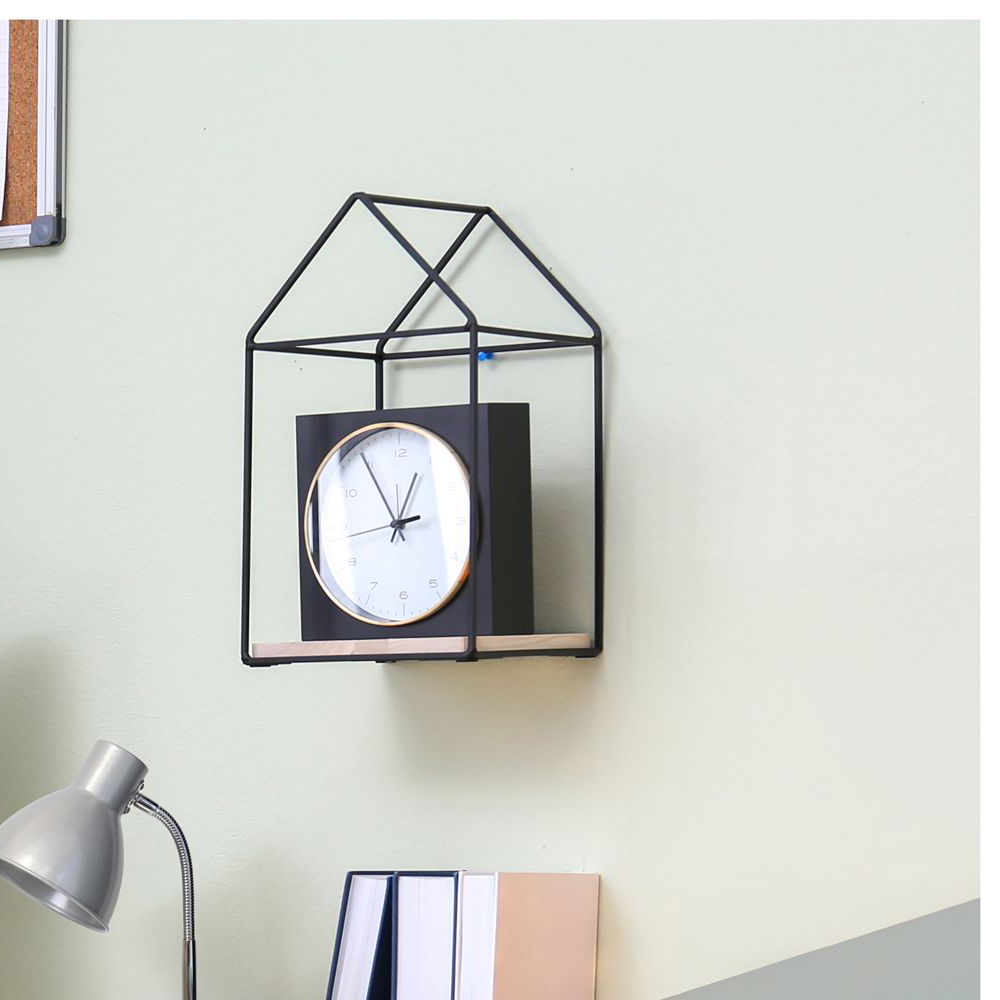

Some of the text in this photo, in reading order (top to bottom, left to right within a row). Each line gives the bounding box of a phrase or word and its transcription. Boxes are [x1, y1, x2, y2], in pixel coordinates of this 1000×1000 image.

[394, 448, 408, 458] 12
[345, 488, 358, 498] 10
[370, 581, 379, 590] 7
[429, 579, 439, 589] 5
[398, 591, 408, 600] 6
